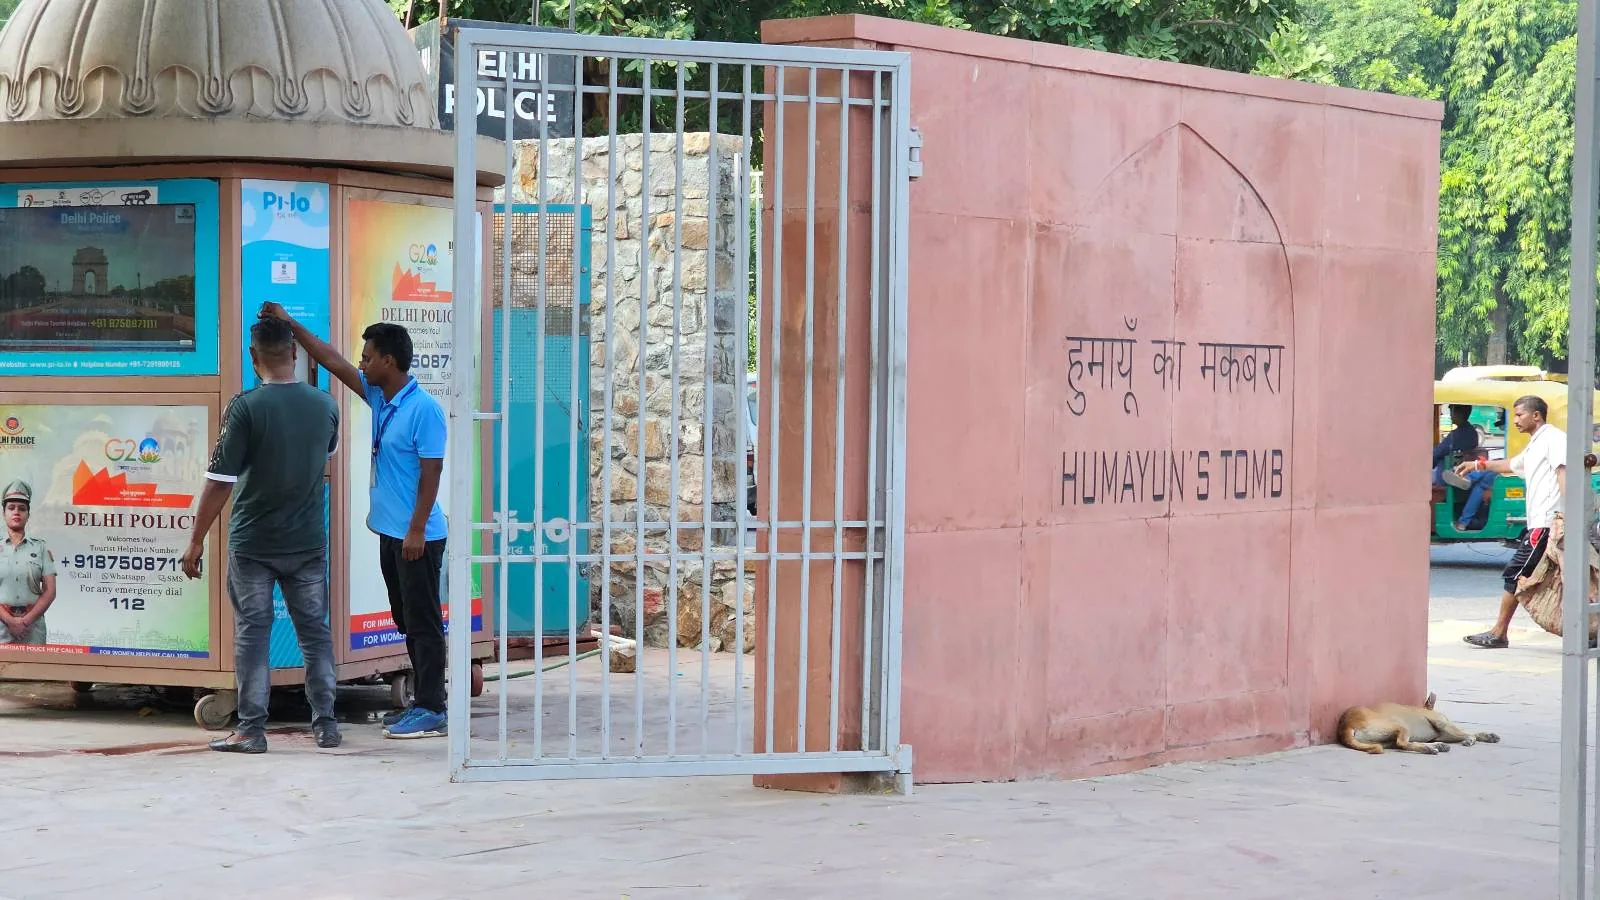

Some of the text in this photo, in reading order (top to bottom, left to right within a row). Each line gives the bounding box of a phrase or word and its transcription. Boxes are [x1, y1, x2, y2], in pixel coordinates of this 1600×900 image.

[477, 51, 542, 81] ELHI
[61, 212, 121, 225] Delhi Police
[382, 307, 453, 324] DELHI POLIC
[1065, 315, 1285, 417] हुमायूँ का मकबरा
[10, 436, 36, 445] POLICE
[1062, 449, 1283, 505] HUMAYUN'S TOMB
[64, 511, 196, 530] DELHI POLIC
[106, 535, 140, 543] Welcomes
[90, 544, 179, 554] Tourist Helpline Number
[110, 572, 146, 582] Whatsapp
[80, 584, 182, 597] For any emergency dial
[109, 597, 145, 611] 112
[363, 620, 376, 630] FOR
[363, 635, 379, 646] FOR
